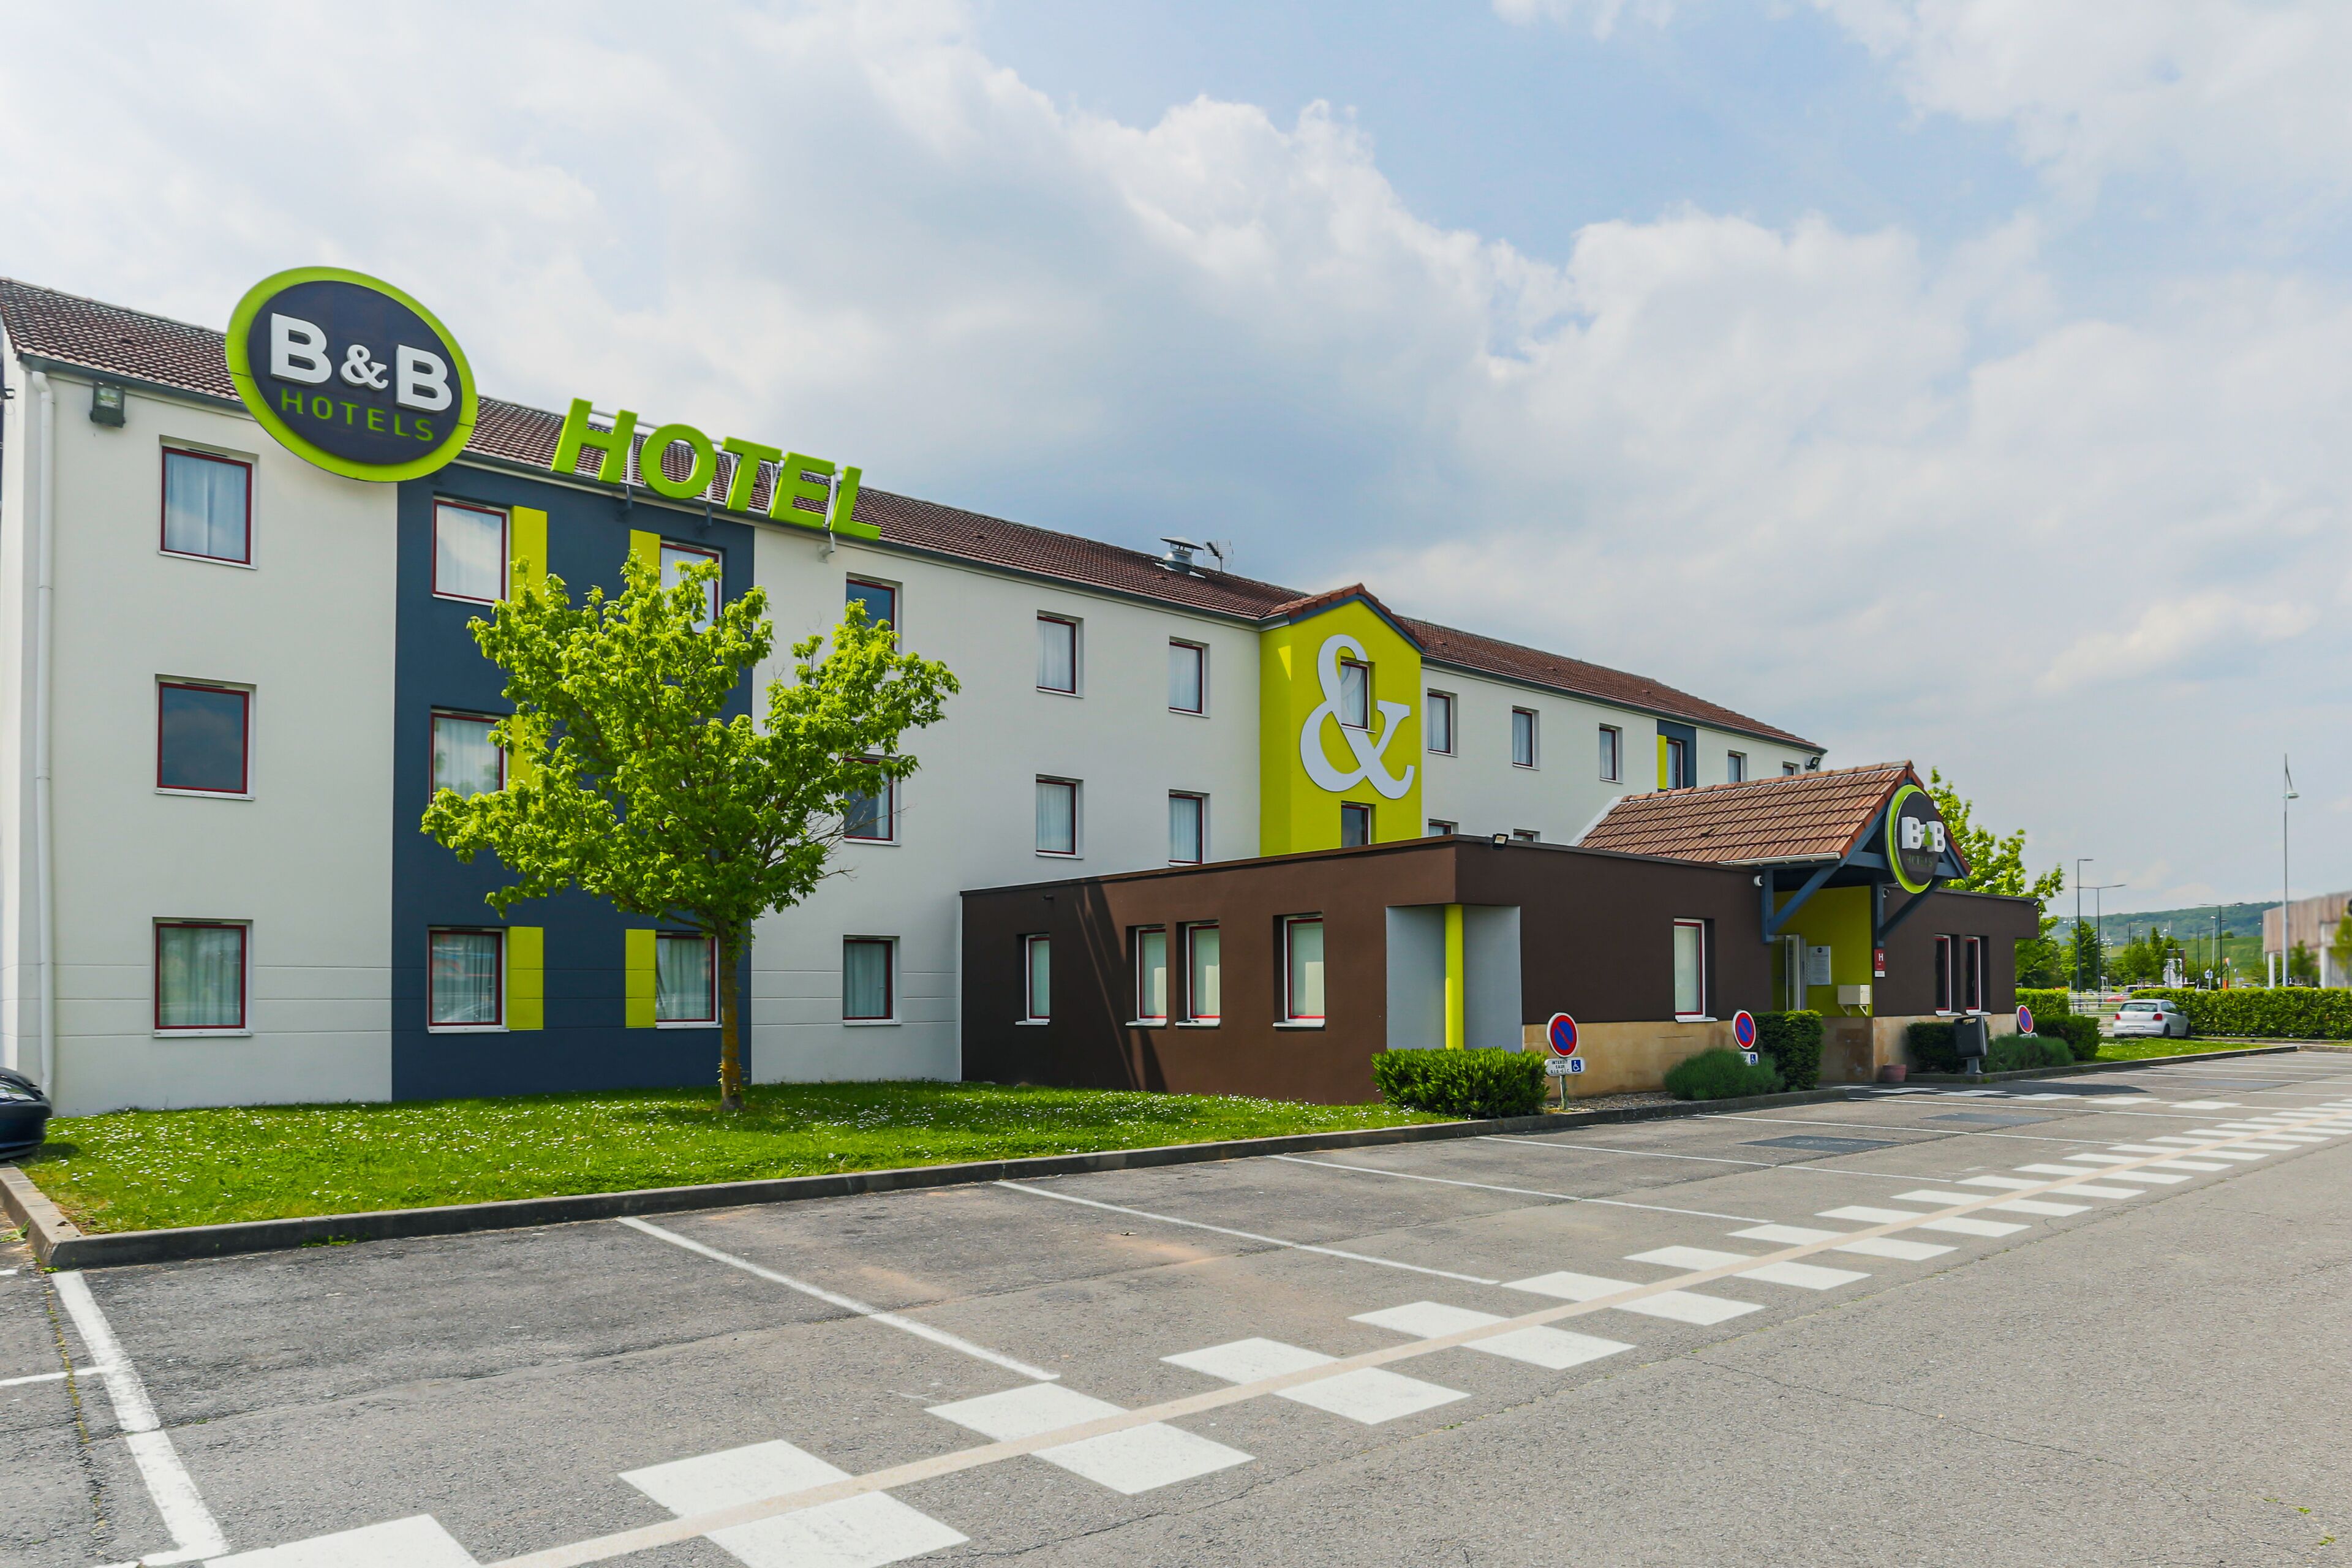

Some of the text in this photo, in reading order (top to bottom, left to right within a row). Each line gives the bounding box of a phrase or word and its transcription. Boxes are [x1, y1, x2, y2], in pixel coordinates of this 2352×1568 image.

[271, 312, 453, 413] B&B
[281, 387, 434, 441] HOTELS
[551, 398, 881, 541] HOTEL
[1299, 633, 1415, 799] &
[1901, 816, 1946, 853] B&B
